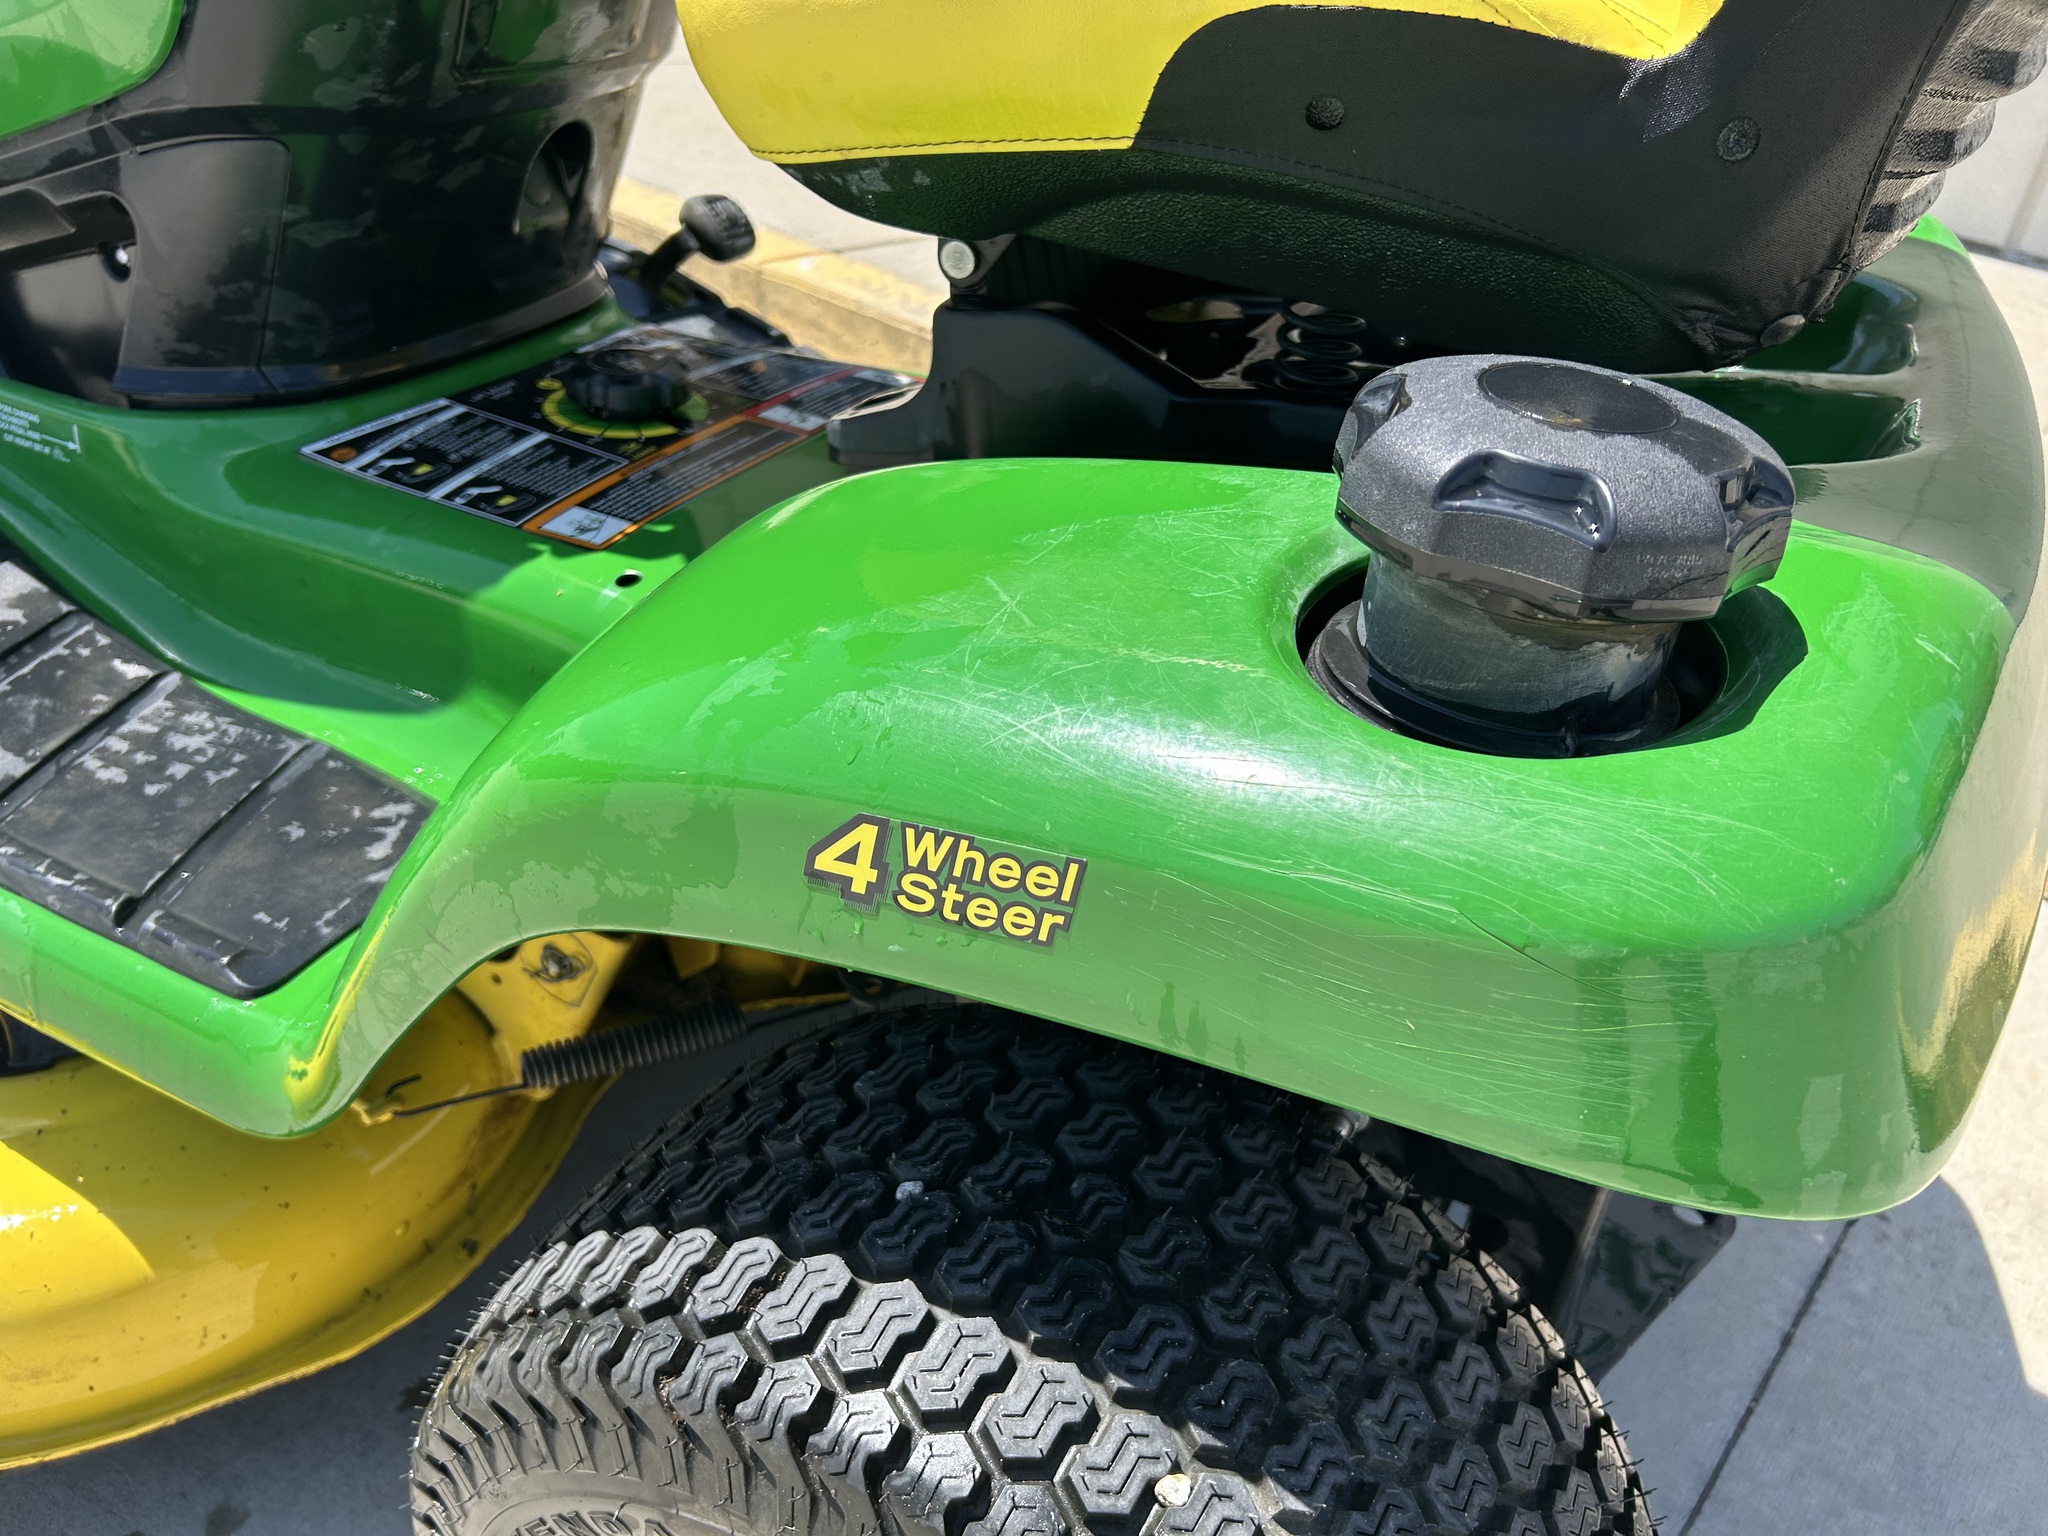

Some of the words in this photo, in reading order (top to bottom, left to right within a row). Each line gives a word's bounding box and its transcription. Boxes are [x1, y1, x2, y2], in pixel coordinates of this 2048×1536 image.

[813, 822, 879, 895] 4
[905, 826, 1080, 902] Wheel
[896, 872, 1065, 943] Steer
